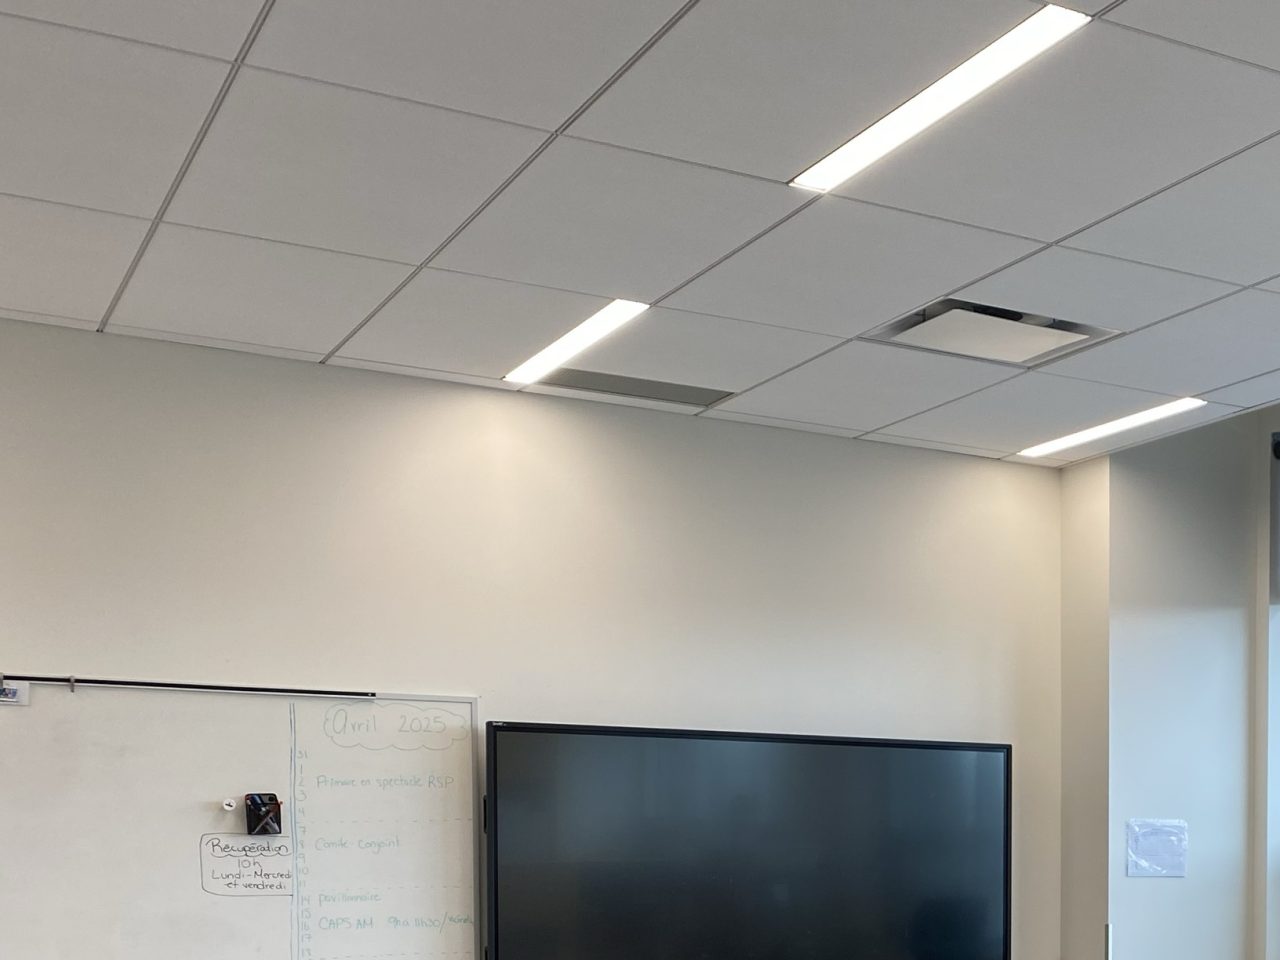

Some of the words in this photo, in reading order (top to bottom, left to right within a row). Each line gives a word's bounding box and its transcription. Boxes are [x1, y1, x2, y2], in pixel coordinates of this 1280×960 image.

[331, 708, 377, 735] Avril
[397, 714, 447, 734] 2025
[360, 778, 371, 787] en
[427, 774, 456, 789] RSP
[317, 915, 353, 931] CAPS
